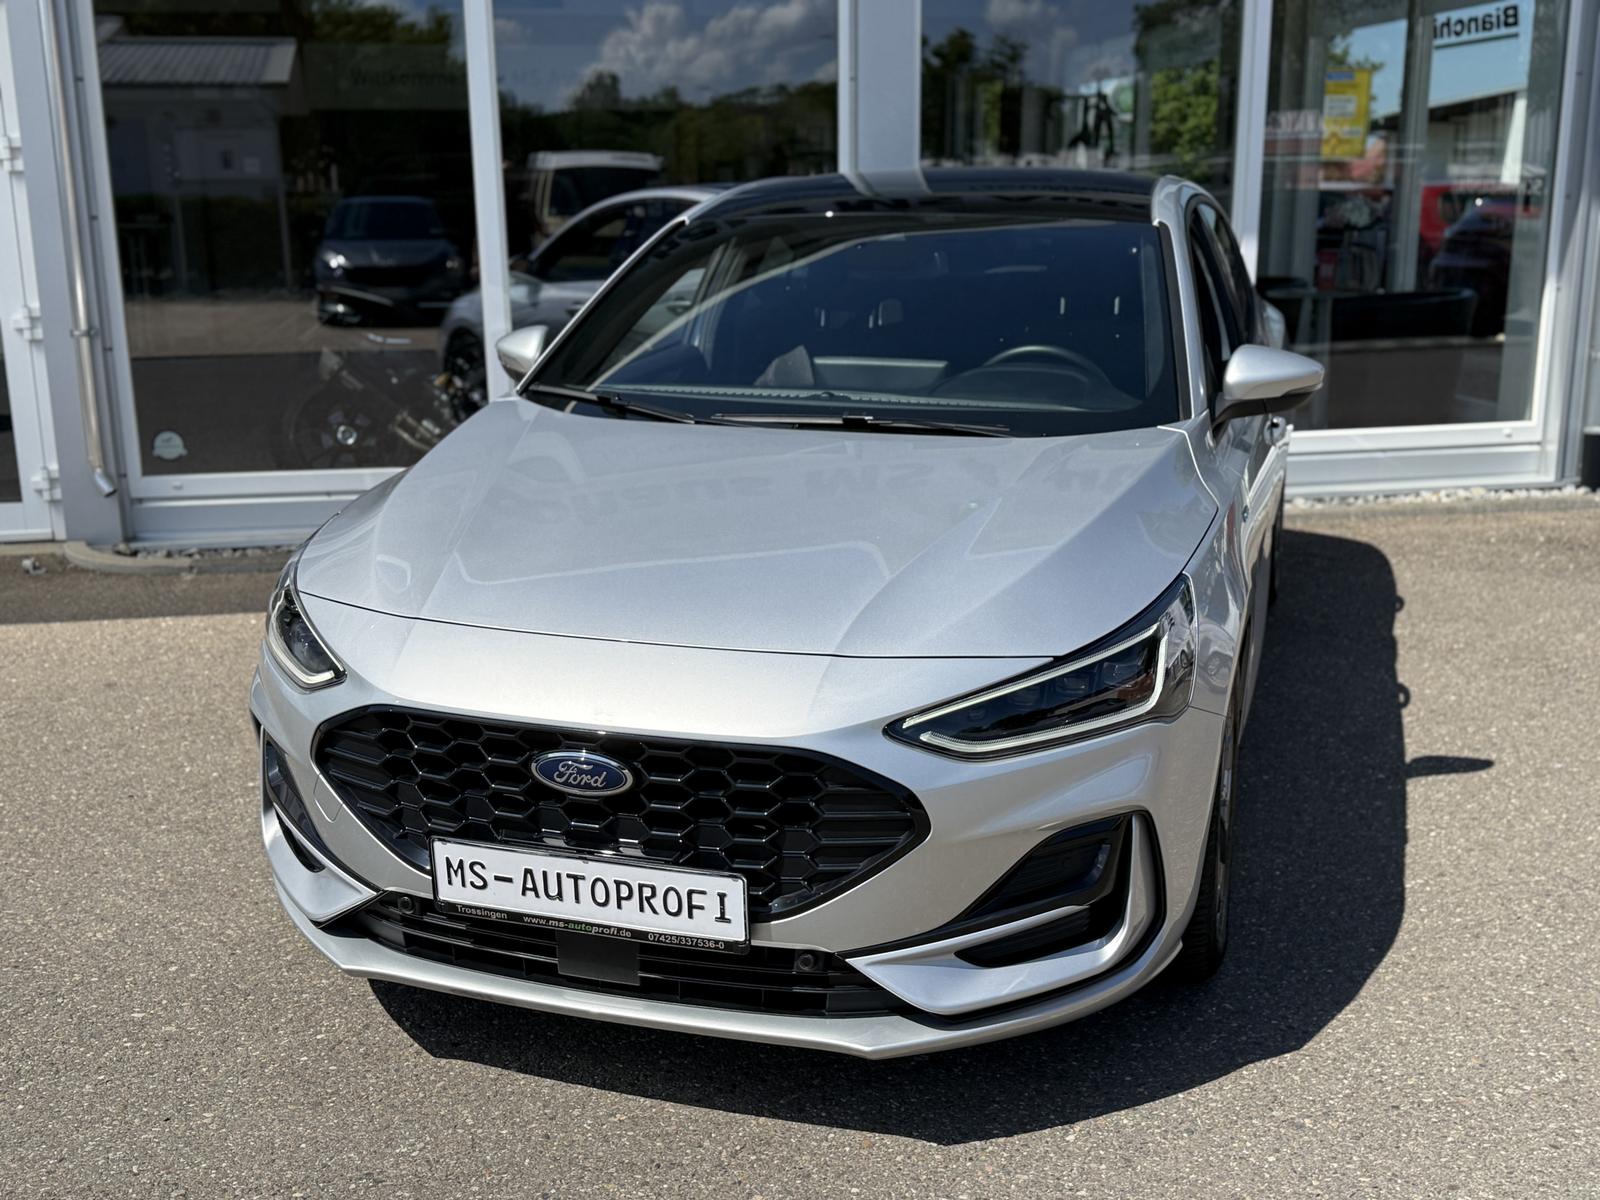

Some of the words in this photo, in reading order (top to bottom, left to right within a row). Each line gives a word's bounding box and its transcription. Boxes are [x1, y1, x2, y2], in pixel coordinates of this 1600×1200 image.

[554, 761, 607, 787] Ford
[445, 856, 731, 924] MS-AUTOPROFI
[456, 904, 508, 919] Trossingen
[523, 915, 632, 937] www.ms-autoprofi.de
[648, 932, 725, 949] 07425/337536-0
